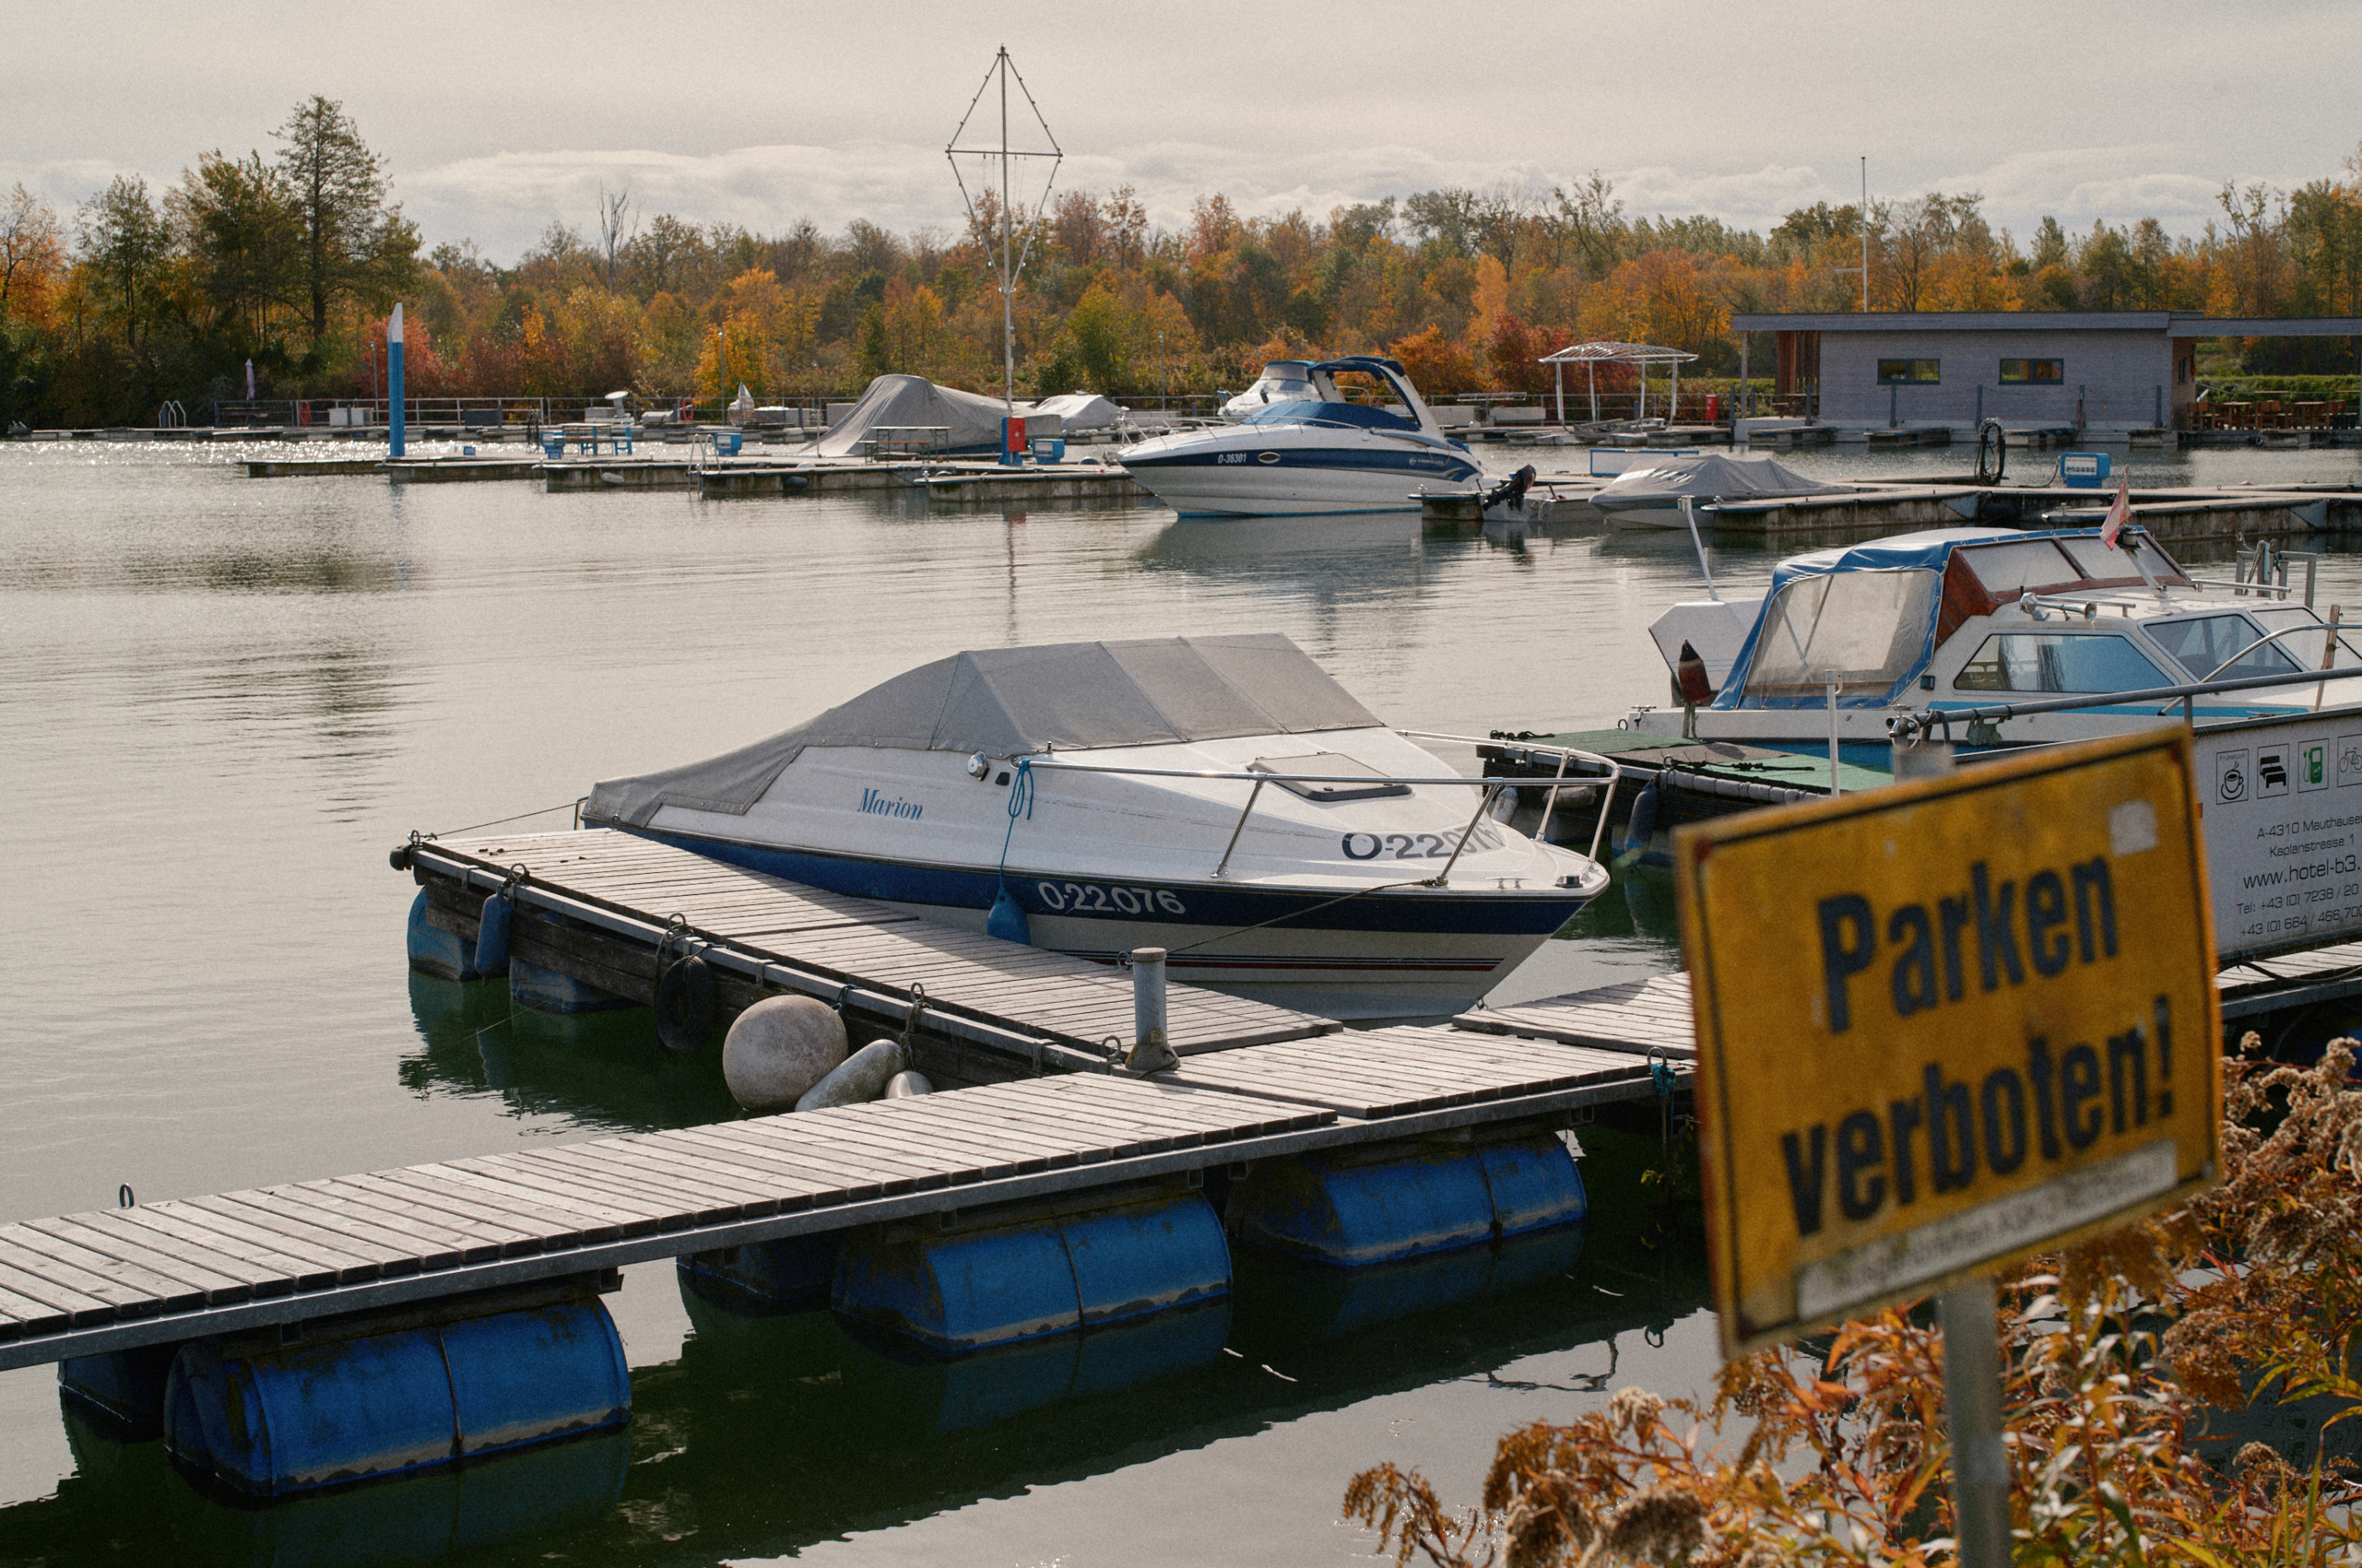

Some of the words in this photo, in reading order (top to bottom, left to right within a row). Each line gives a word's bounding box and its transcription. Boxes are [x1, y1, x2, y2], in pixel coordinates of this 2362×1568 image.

[856, 788, 923, 821] Marion
[2257, 822, 2300, 839] A-4310
[2303, 816, 2362, 832] Mauthause
[2269, 838, 2344, 858] Kaplanstrasse
[2349, 833, 2354, 844] 1
[2236, 902, 2256, 915] Tel:
[2261, 897, 2283, 911] +43
[2286, 893, 2300, 907] (0)
[2304, 888, 2334, 903] 7238
[2337, 886, 2341, 899] /
[2343, 883, 2359, 897] 20
[2241, 923, 2262, 936] +43
[2267, 919, 2281, 933] (0)
[2284, 915, 2307, 929] 664
[2311, 913, 2316, 924] /
[2317, 909, 2340, 922] 466
[1818, 857, 2120, 1034] Parken
[1780, 994, 2174, 1237] verboten!
